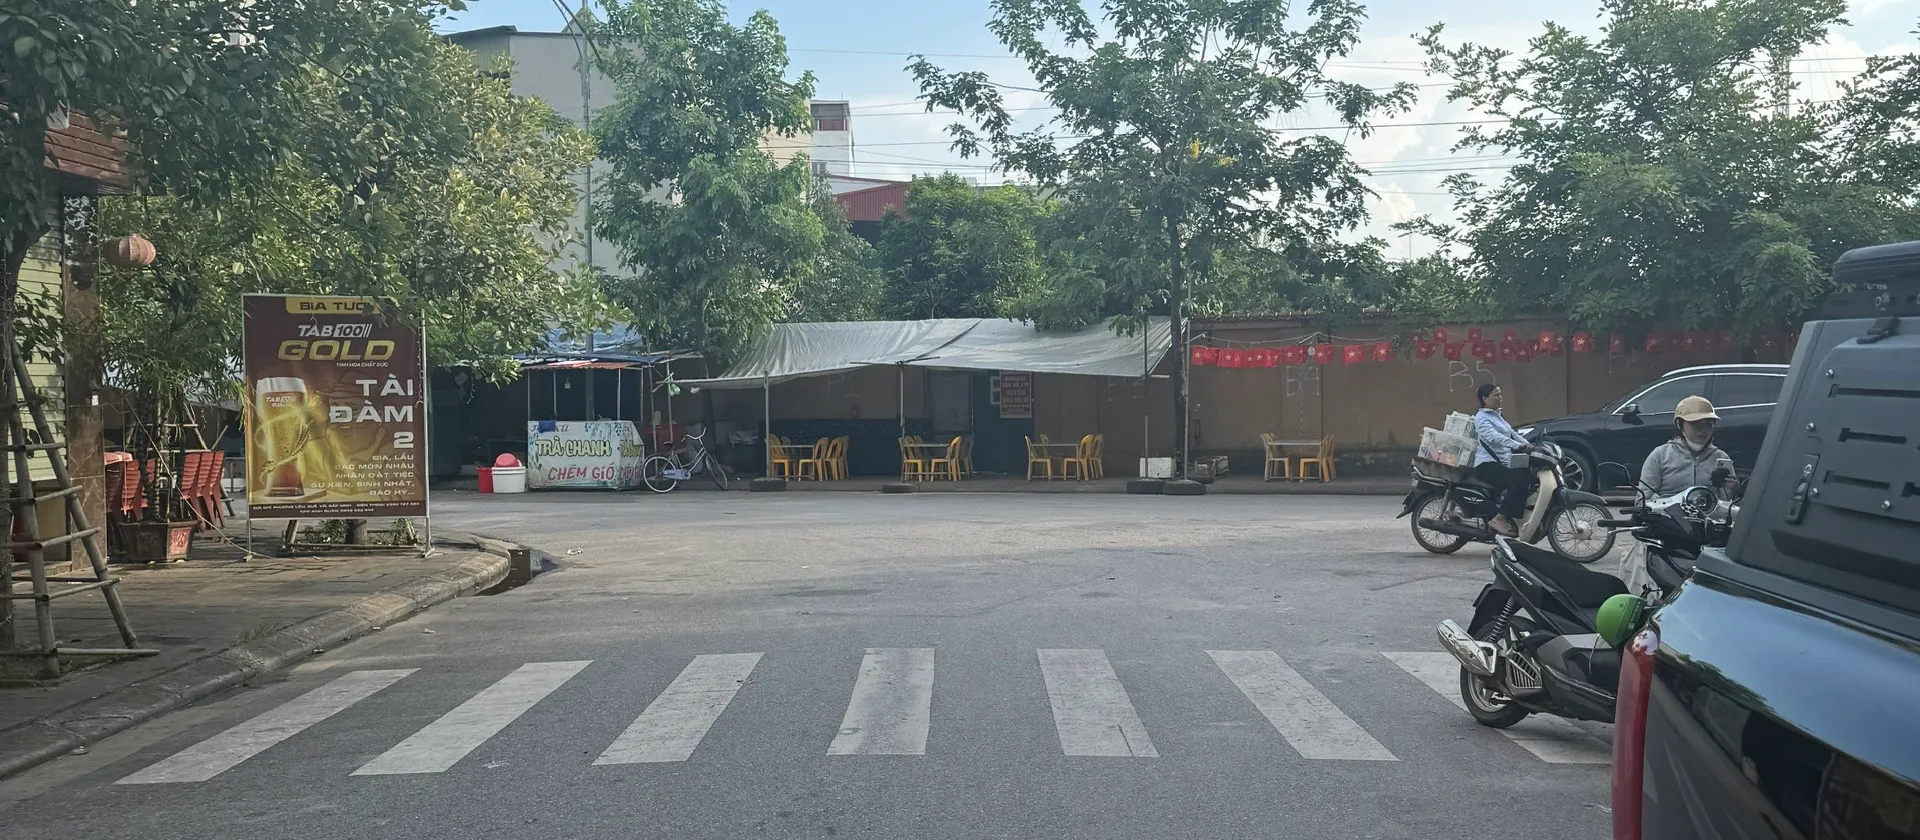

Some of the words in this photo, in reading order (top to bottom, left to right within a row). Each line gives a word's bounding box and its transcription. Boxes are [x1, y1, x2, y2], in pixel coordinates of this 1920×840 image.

[300, 301, 327, 311] BIA
[278, 339, 395, 361] GOLD
[356, 373, 414, 397] TÀI
[328, 399, 414, 424] ĐÀM
[393, 431, 414, 449] 2
[535, 435, 564, 457] TRÀ
[564, 440, 612, 457] CHANH
